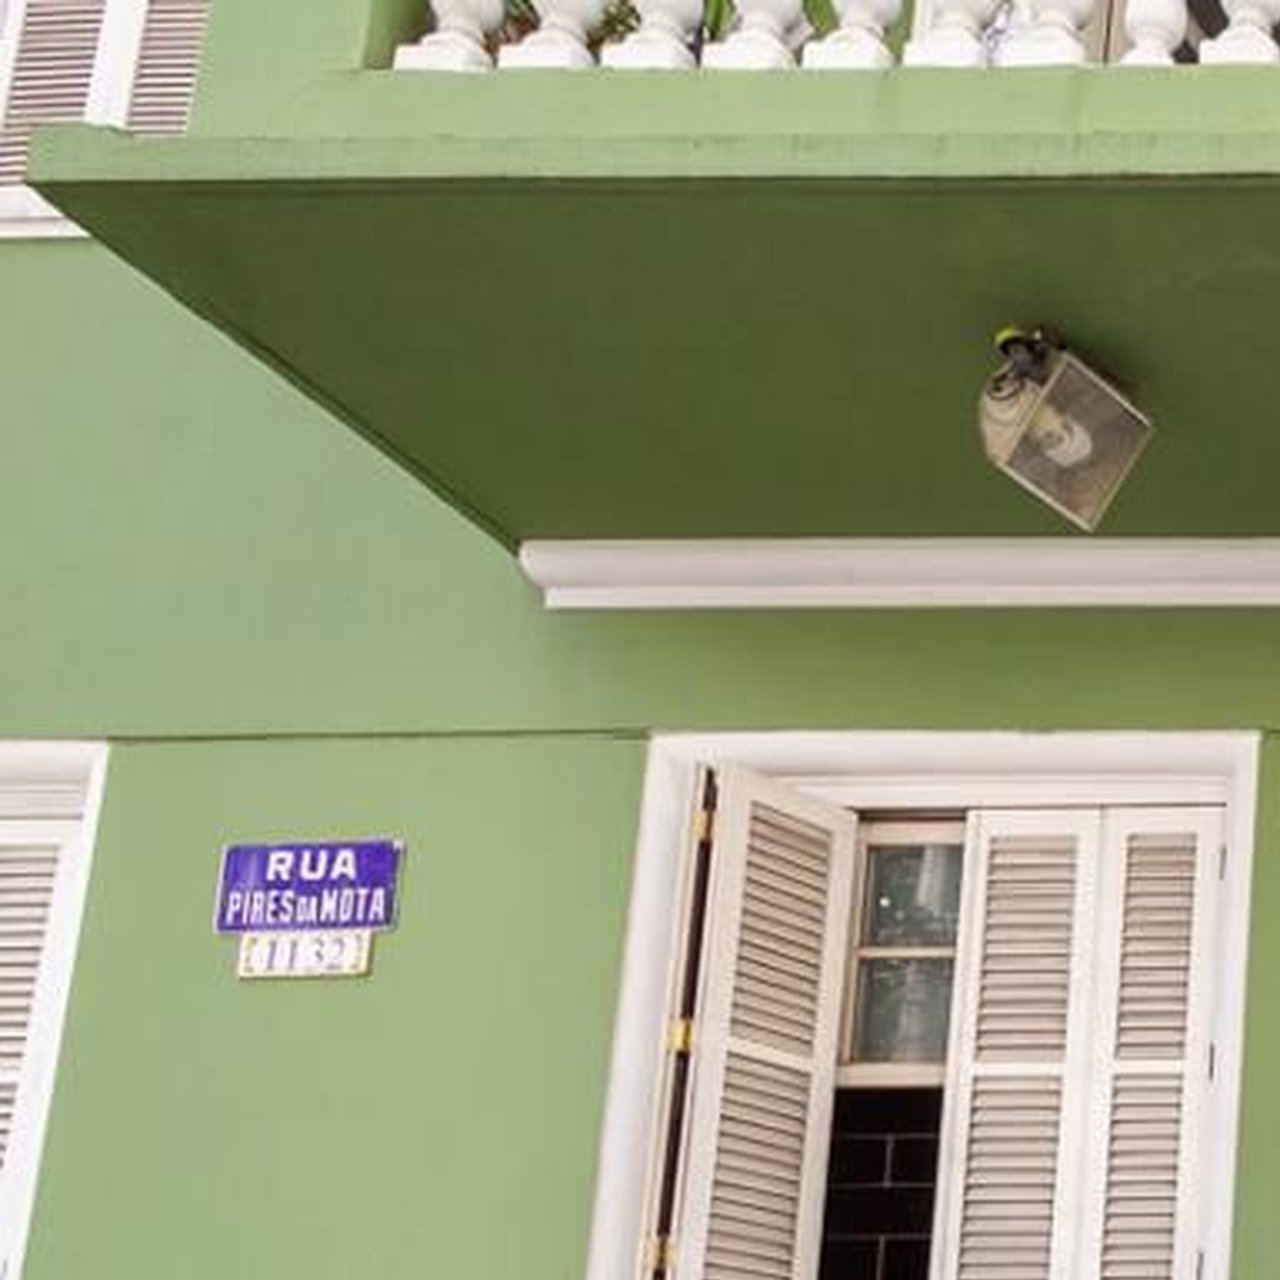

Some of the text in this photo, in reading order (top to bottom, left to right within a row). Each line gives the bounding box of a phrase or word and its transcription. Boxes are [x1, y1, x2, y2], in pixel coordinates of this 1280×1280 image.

[266, 850, 357, 881] RUA
[226, 888, 295, 924] PIRES
[320, 887, 386, 921] MOTA
